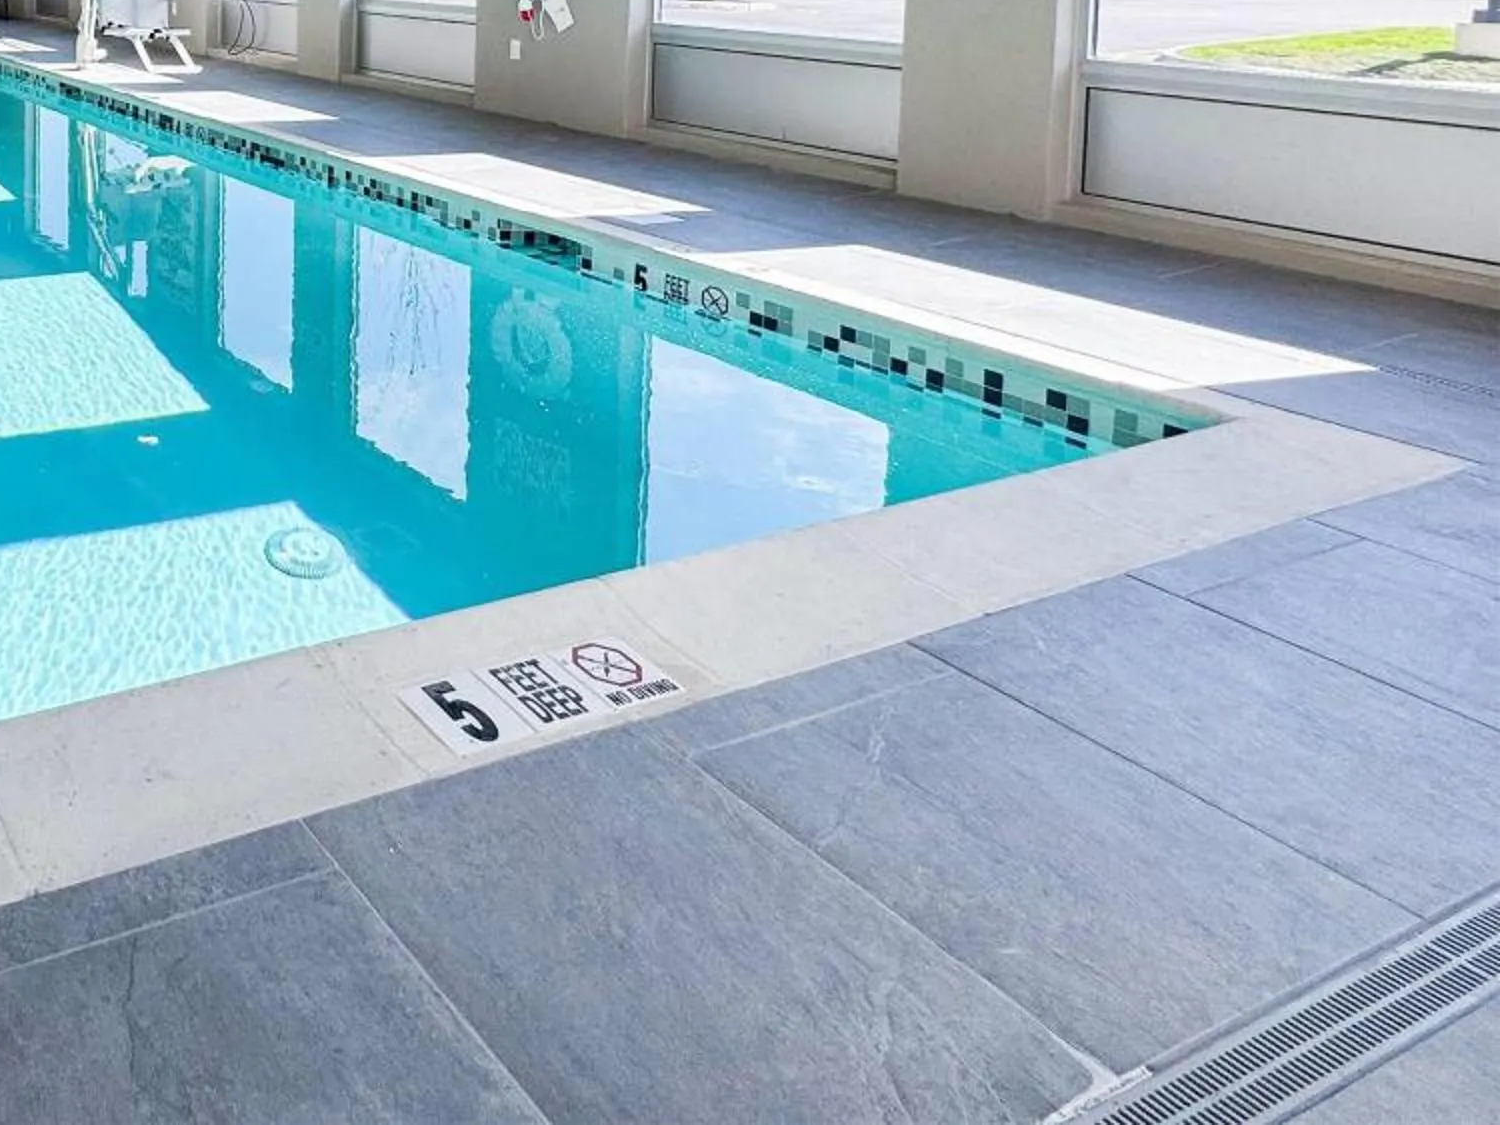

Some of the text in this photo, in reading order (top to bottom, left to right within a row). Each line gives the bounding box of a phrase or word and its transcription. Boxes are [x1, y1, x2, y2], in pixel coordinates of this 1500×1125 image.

[634, 262, 648, 292] 5
[665, 273, 690, 294] FEET
[488, 659, 558, 695] FEET
[606, 679, 680, 706] NO DIVING
[421, 680, 499, 742] 5
[518, 685, 589, 723] DEEP
